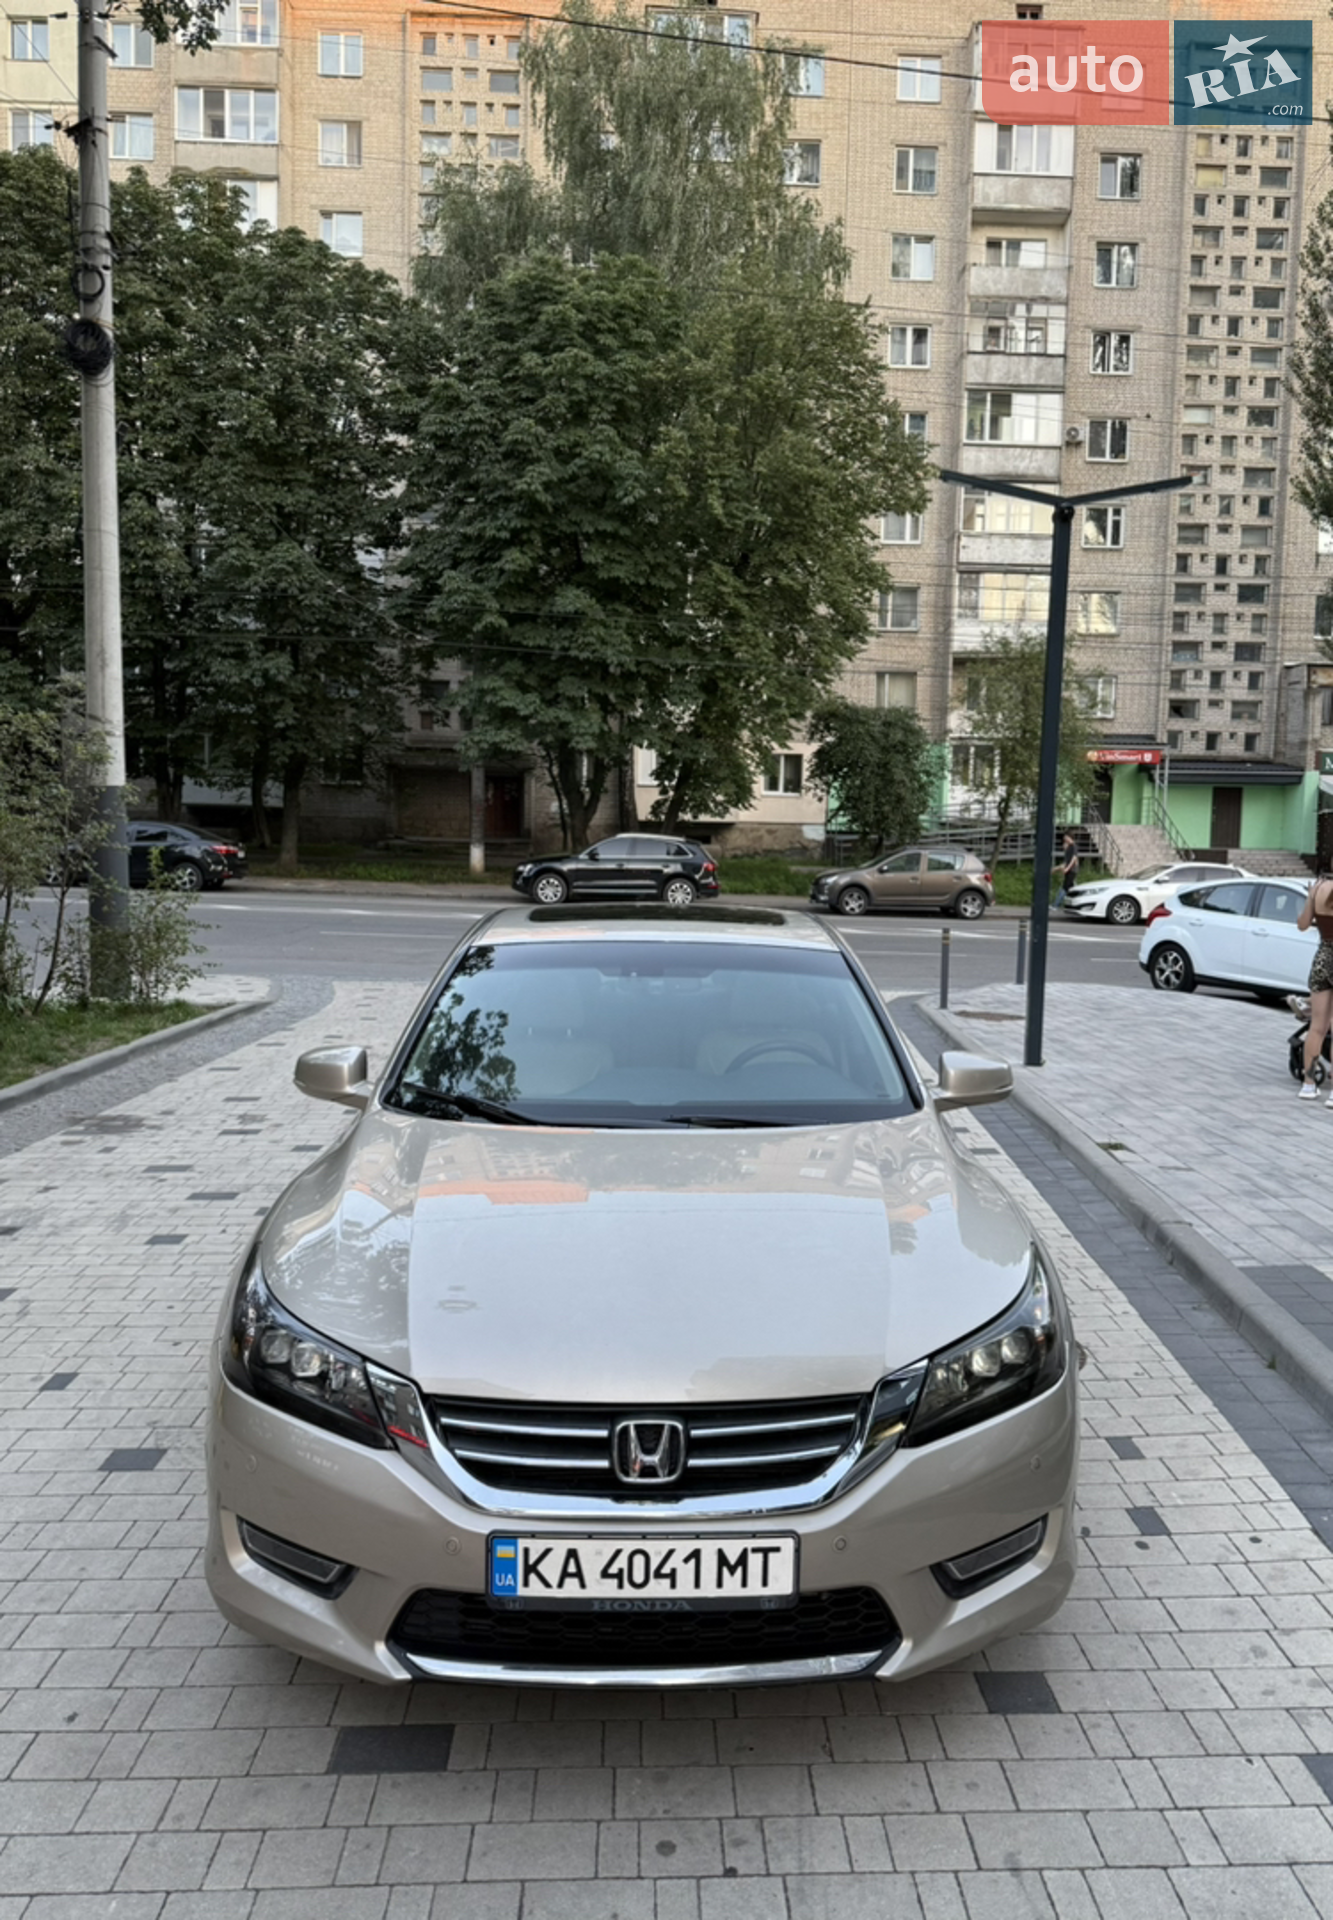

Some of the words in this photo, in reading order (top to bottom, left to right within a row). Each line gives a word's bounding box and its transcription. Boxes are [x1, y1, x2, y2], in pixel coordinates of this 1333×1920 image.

[522, 1546, 586, 1588] KA
[600, 1547, 701, 1590] 4041
[716, 1546, 781, 1588] MT
[495, 1573, 515, 1587] UA
[592, 1599, 693, 1611] HONDA
